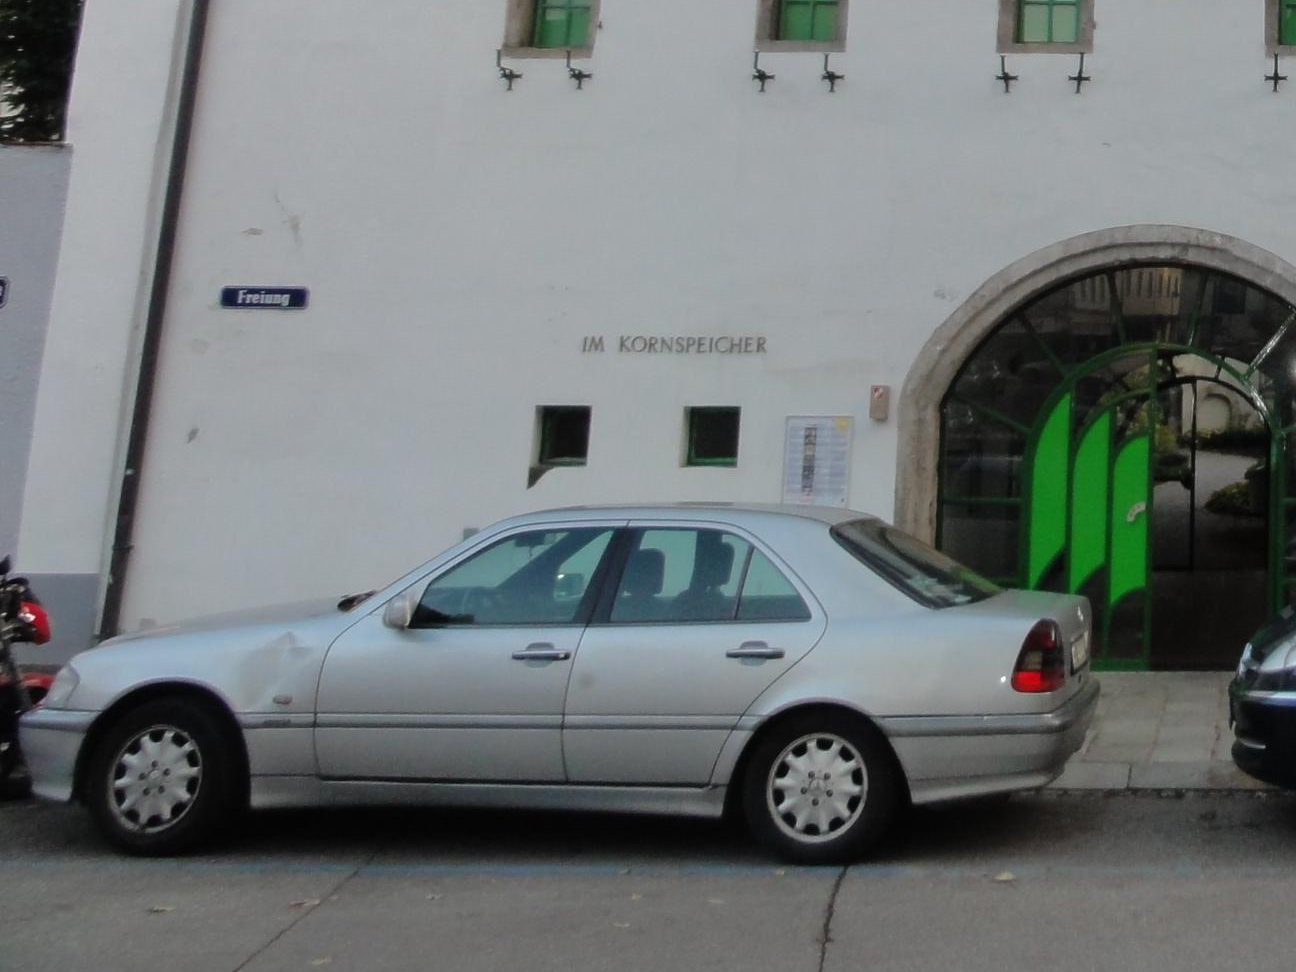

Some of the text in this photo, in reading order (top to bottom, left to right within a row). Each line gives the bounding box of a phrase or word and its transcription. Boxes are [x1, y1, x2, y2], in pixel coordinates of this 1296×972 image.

[237, 289, 291, 307] Freiung
[582, 336, 768, 354] IM KORNSPEICHER
